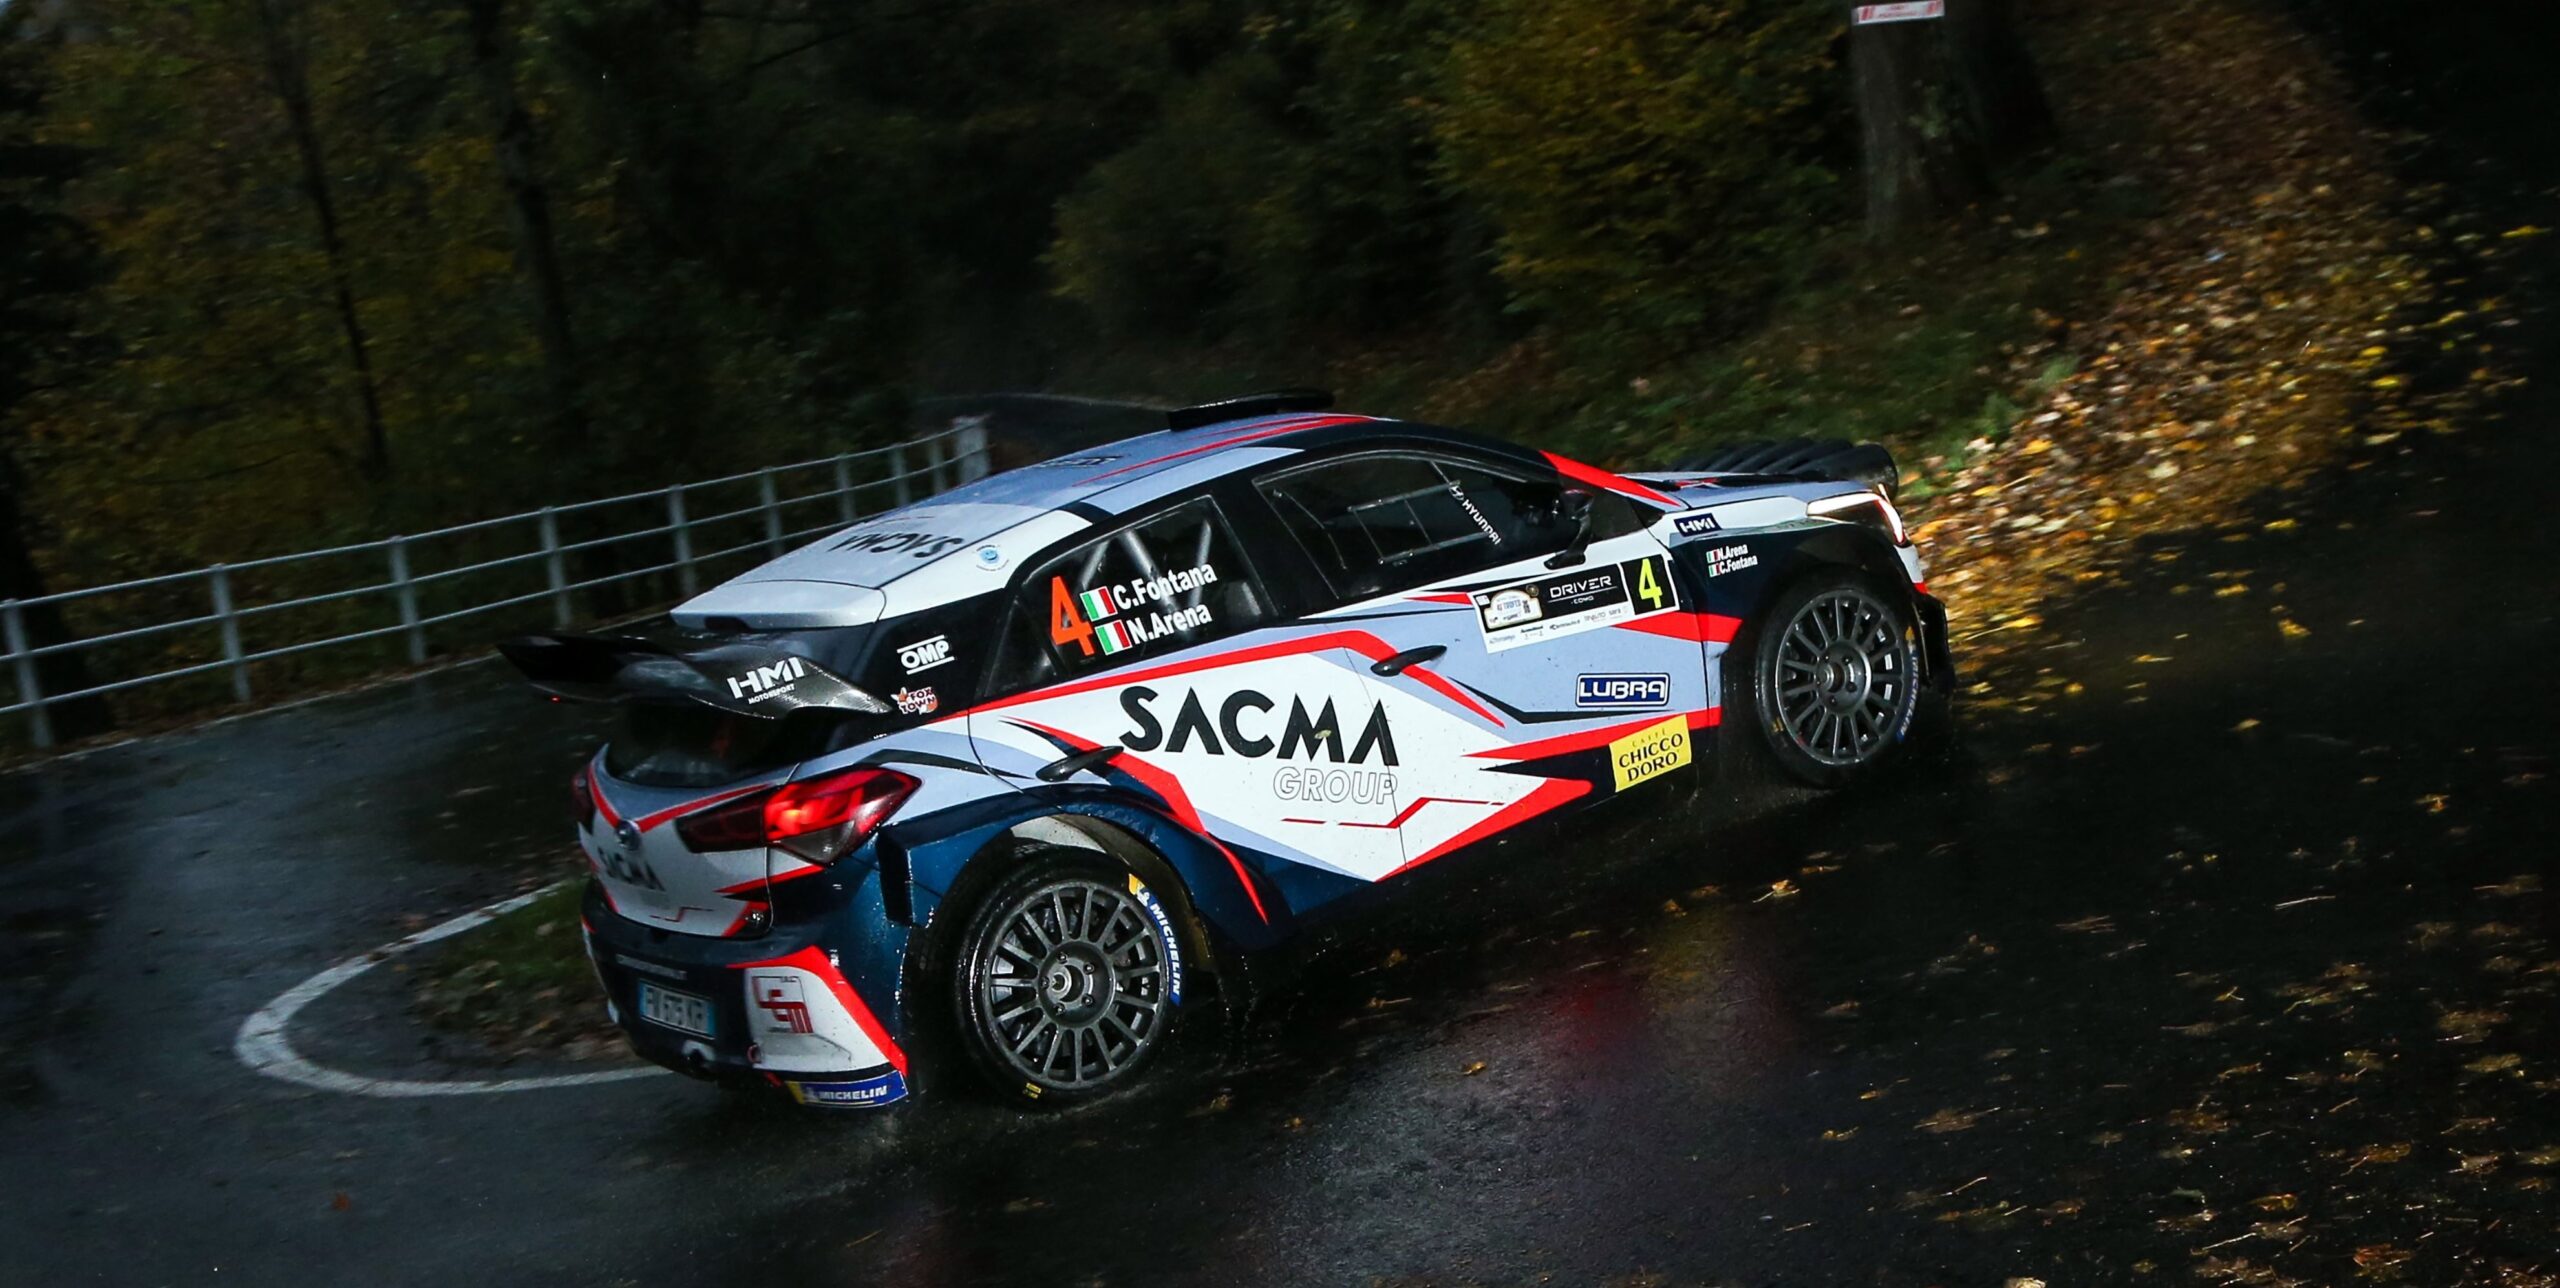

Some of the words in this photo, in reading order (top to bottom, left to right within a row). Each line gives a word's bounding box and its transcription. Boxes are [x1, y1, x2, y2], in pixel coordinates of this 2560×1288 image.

[1462, 499, 1501, 545] HYUNDAI
[1680, 518, 1715, 533] HMI
[1719, 544, 1748, 560] N.Arena
[1720, 555, 1758, 574] C.Fontana
[1113, 563, 1218, 610] C.Fontana
[1550, 575, 1612, 598] DRIVER
[1638, 558, 1663, 609] 4
[1051, 575, 1095, 656] 4
[1126, 604, 1213, 645] N.Arena
[901, 640, 950, 669] OMP
[727, 656, 805, 699] HMI
[1580, 681, 1665, 699] LUBRA
[748, 683, 795, 704] MOTORSPORT
[901, 695, 937, 714] TOWN
[910, 687, 934, 700] FOX
[1119, 686, 1399, 766] SACMA
[1618, 733, 1683, 768] CHICCO
[1627, 752, 1677, 781] D'ORO
[1273, 767, 1398, 805] GROUP
[1150, 903, 1180, 996] MICHELIN
[818, 1085, 888, 1100] MICHELIN
